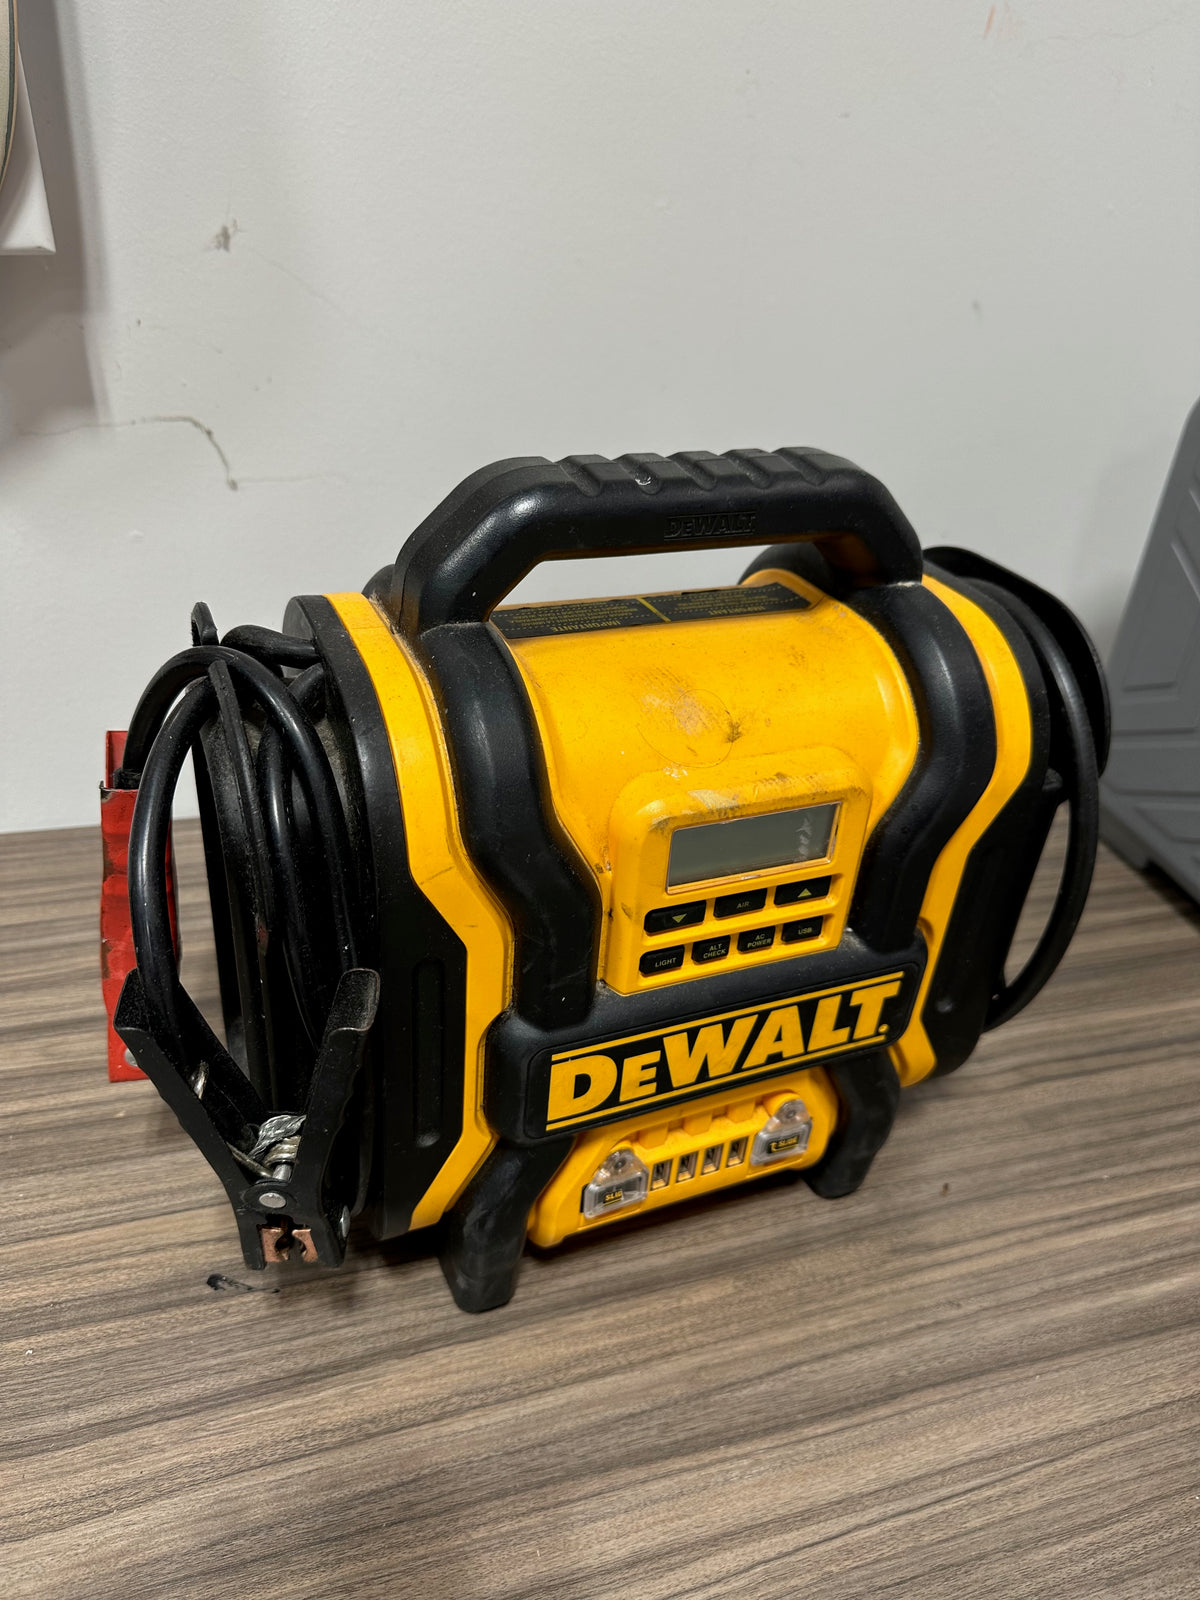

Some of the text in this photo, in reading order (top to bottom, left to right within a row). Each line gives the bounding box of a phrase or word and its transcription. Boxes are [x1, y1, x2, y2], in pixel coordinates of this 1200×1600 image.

[736, 901, 750, 909] AIR
[797, 927, 813, 936] USB
[755, 933, 766, 941] AC
[709, 943, 722, 952] ALT
[747, 938, 772, 949] POWER
[703, 948, 726, 959] CHECK
[654, 957, 677, 968] LIGHT
